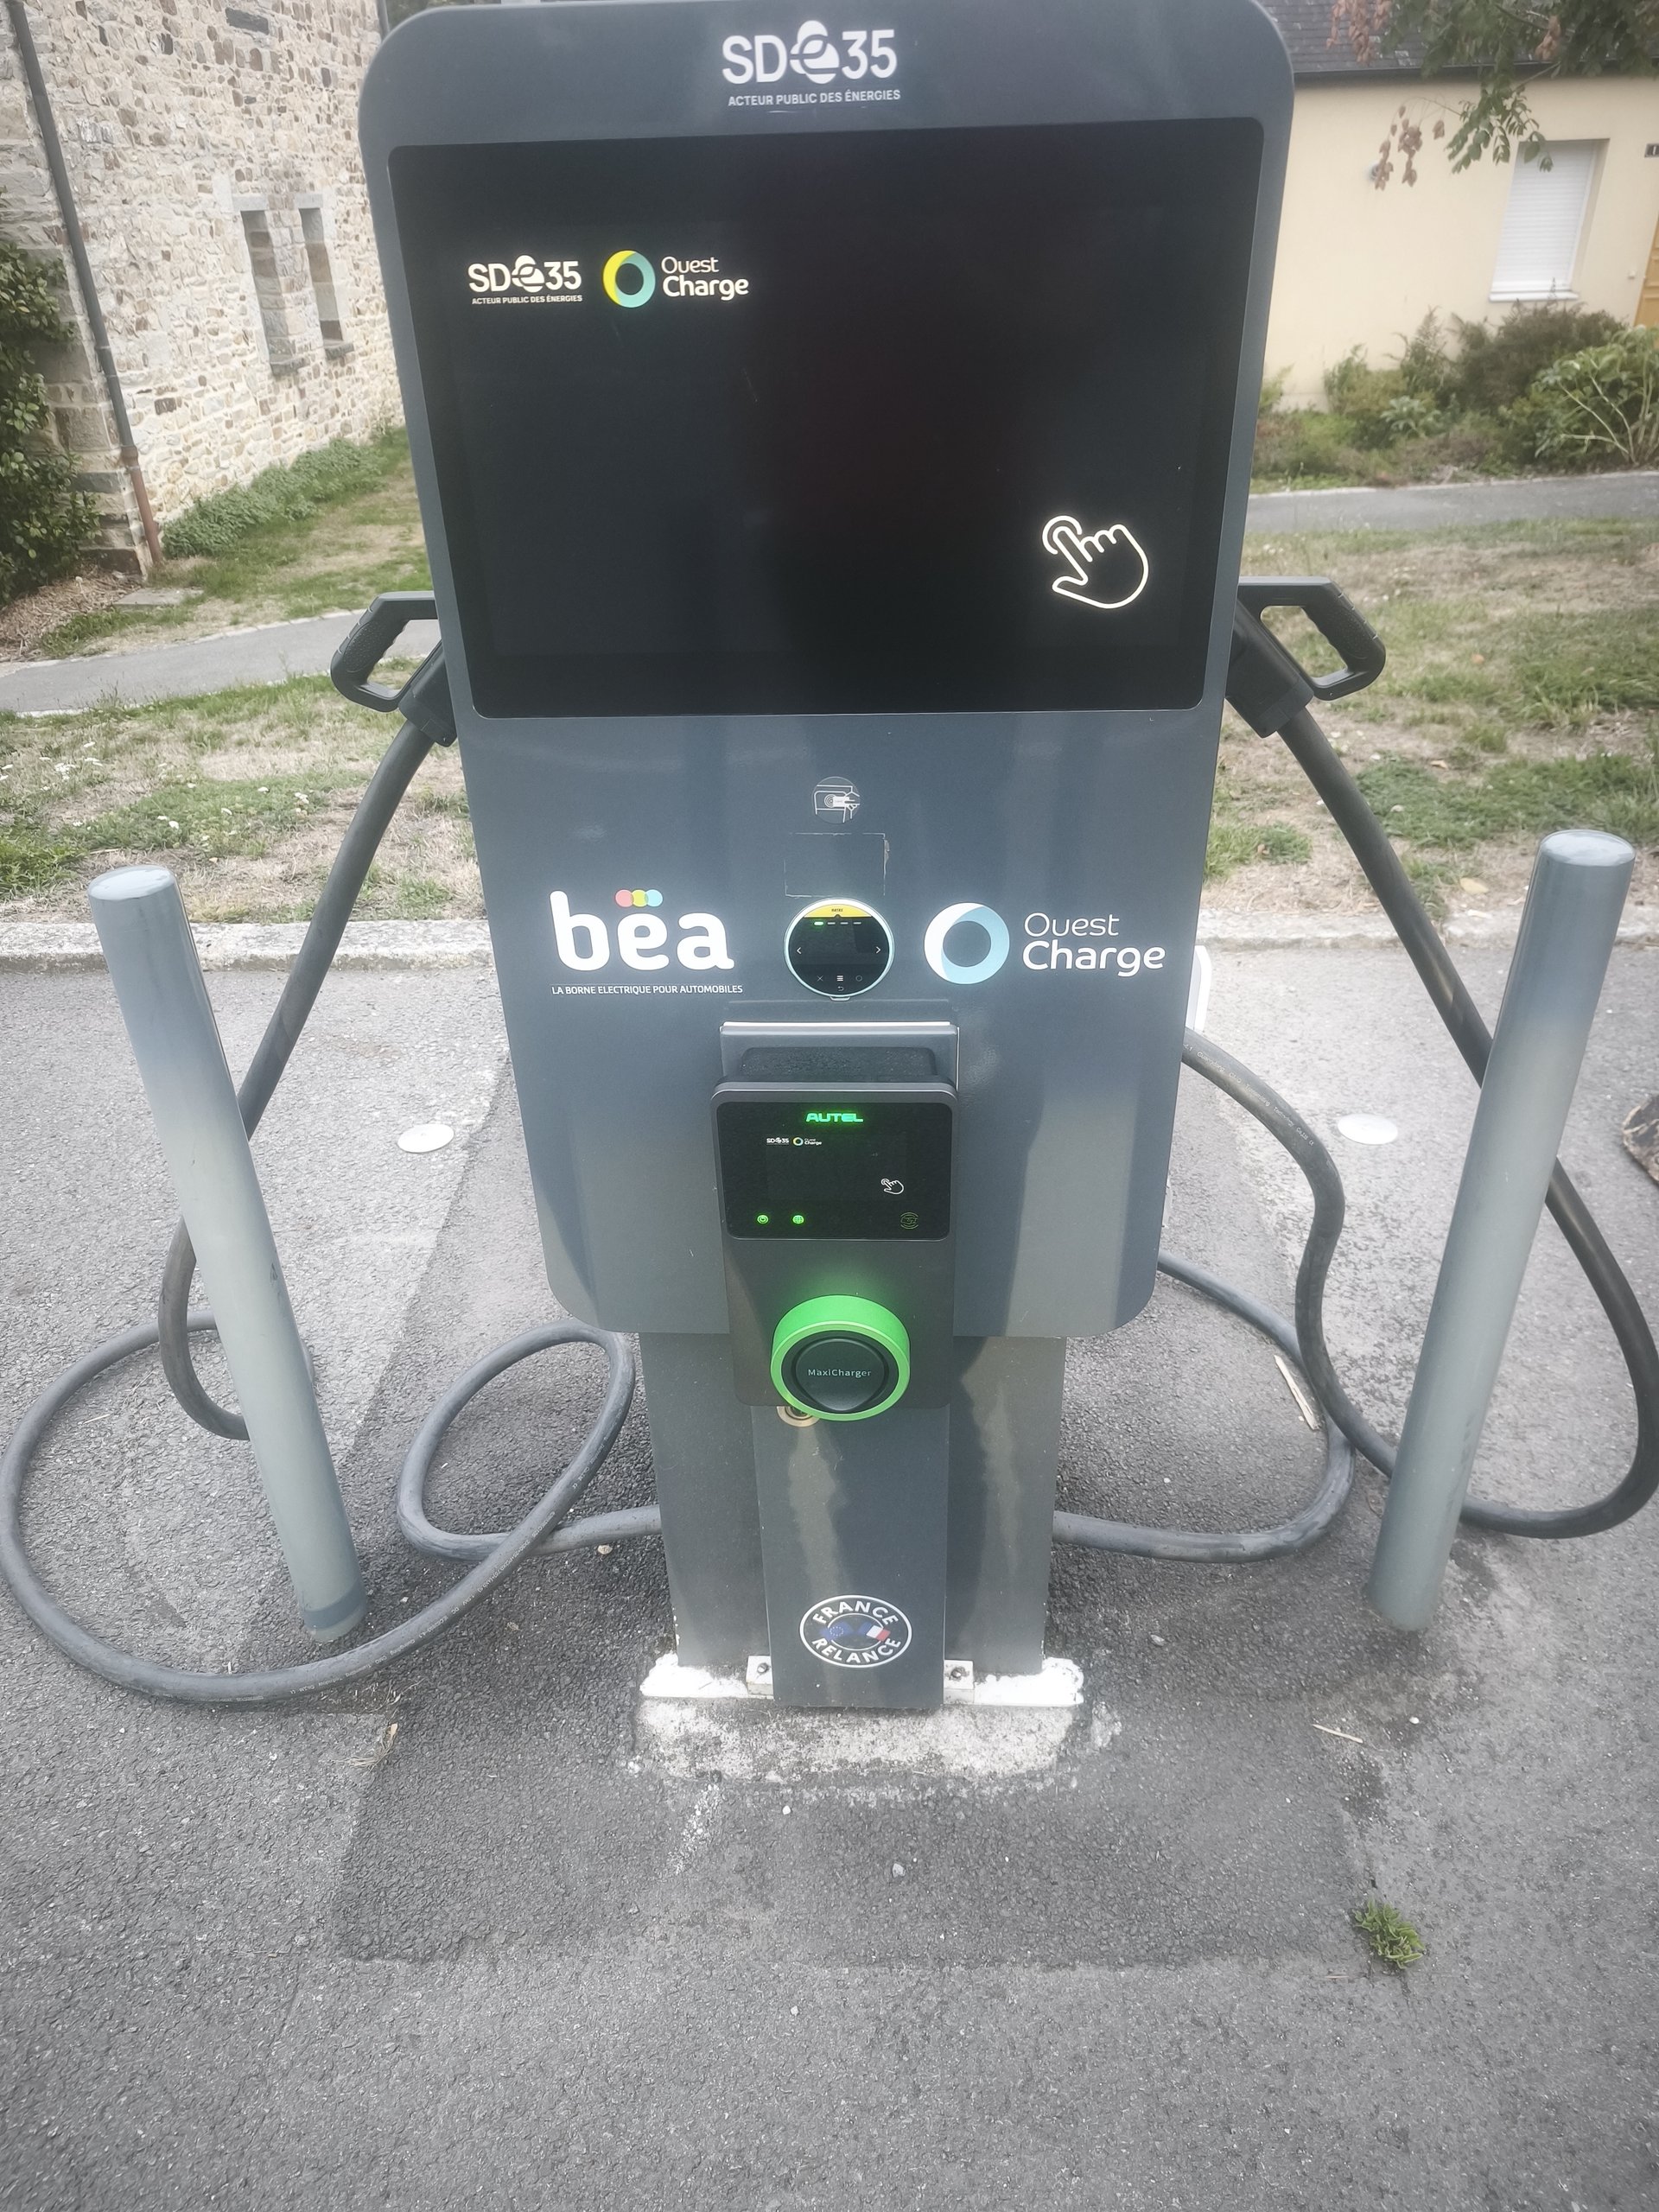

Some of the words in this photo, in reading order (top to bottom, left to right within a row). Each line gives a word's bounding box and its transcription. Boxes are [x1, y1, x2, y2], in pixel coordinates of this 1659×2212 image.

[728, 95, 773, 106] ACTEUR
[776, 93, 817, 105] PUBLIC
[820, 92, 842, 103] DES
[844, 89, 901, 102] ÉNERGIES
[661, 256, 720, 274] Ouest
[662, 275, 749, 301] Charge
[546, 294, 583, 302] ÉNERGIES
[1024, 912, 1120, 938] Ouest
[1022, 939, 1166, 977] Charge
[552, 986, 564, 995] LA
[566, 986, 596, 995] BORNE
[598, 985, 652, 995] ELECTRIQUE
[653, 985, 678, 994] POUR
[679, 985, 743, 994] AUTOMOBILES
[805, 1112, 864, 1122] AUTEL
[808, 1369, 872, 1378] MaxiCharger
[812, 1600, 899, 1624] FRANCE
[812, 1637, 901, 1663] RELANCE
